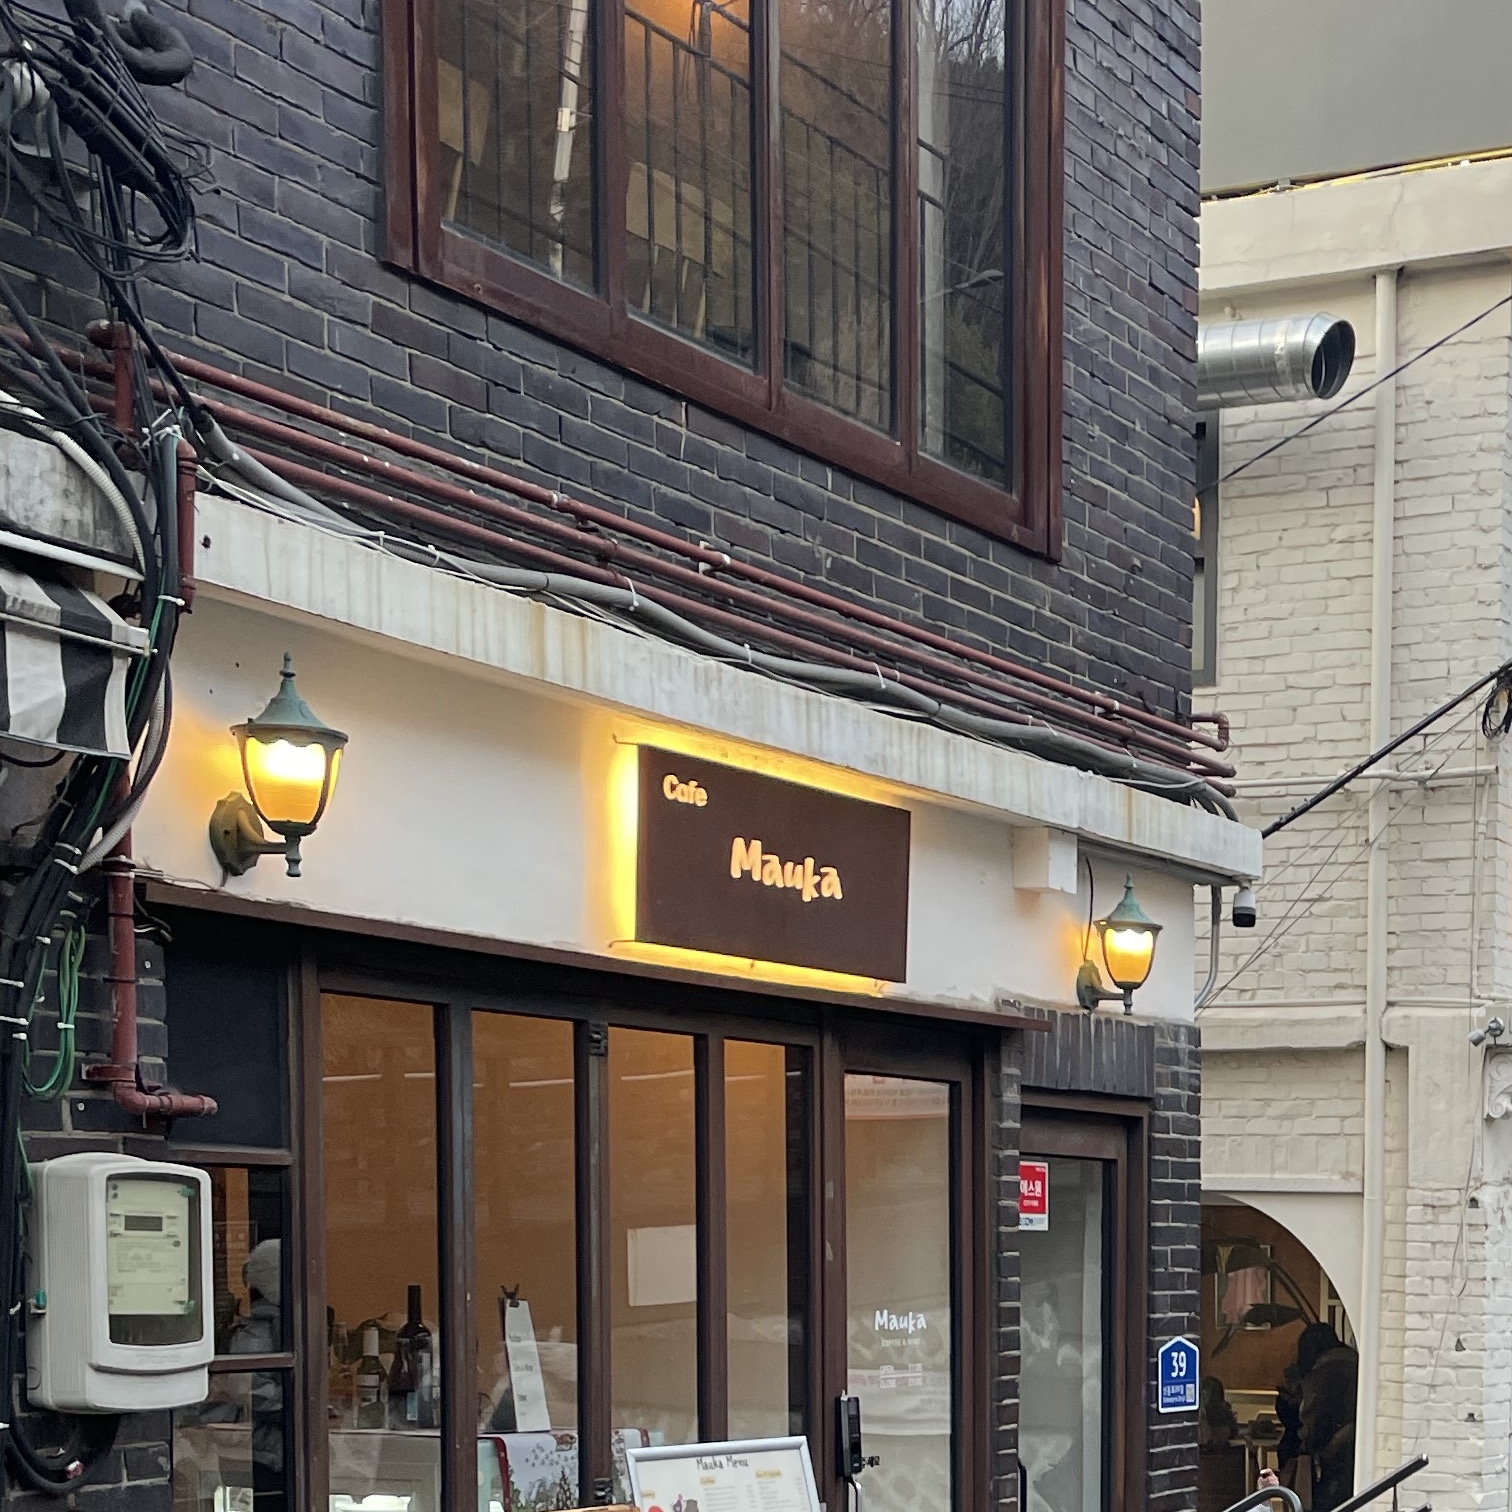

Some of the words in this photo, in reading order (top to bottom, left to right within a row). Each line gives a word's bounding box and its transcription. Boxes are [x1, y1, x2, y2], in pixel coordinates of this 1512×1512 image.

[663, 774, 708, 807] Cafe
[730, 836, 843, 902] Mauka
[874, 1309, 927, 1335] Mauka
[1170, 1351, 1187, 1378] 39
[696, 1456, 724, 1471] Mauka
[726, 1454, 749, 1468] Menu
